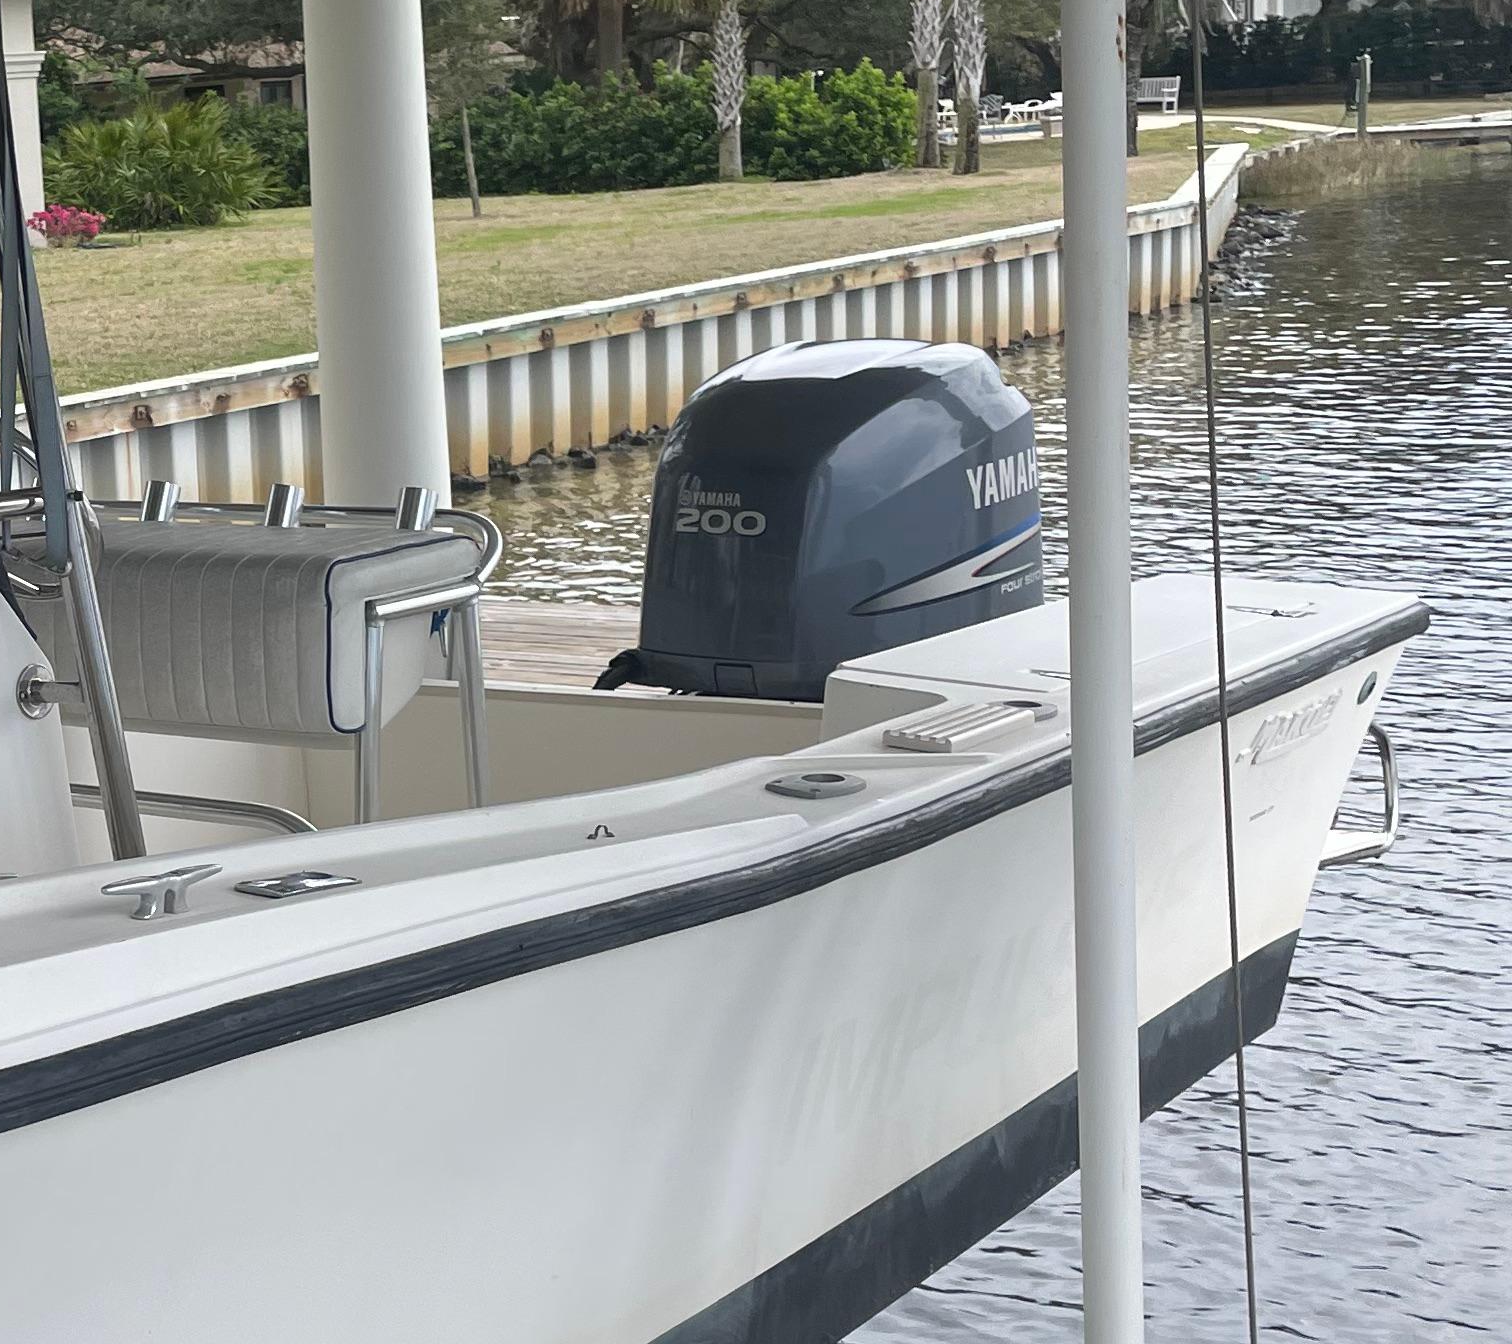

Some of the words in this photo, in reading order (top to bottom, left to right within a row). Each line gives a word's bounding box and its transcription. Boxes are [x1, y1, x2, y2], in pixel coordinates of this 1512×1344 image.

[966, 446, 1038, 510] YAMAH
[693, 491, 741, 507] YAMAHA
[675, 508, 767, 536] 200
